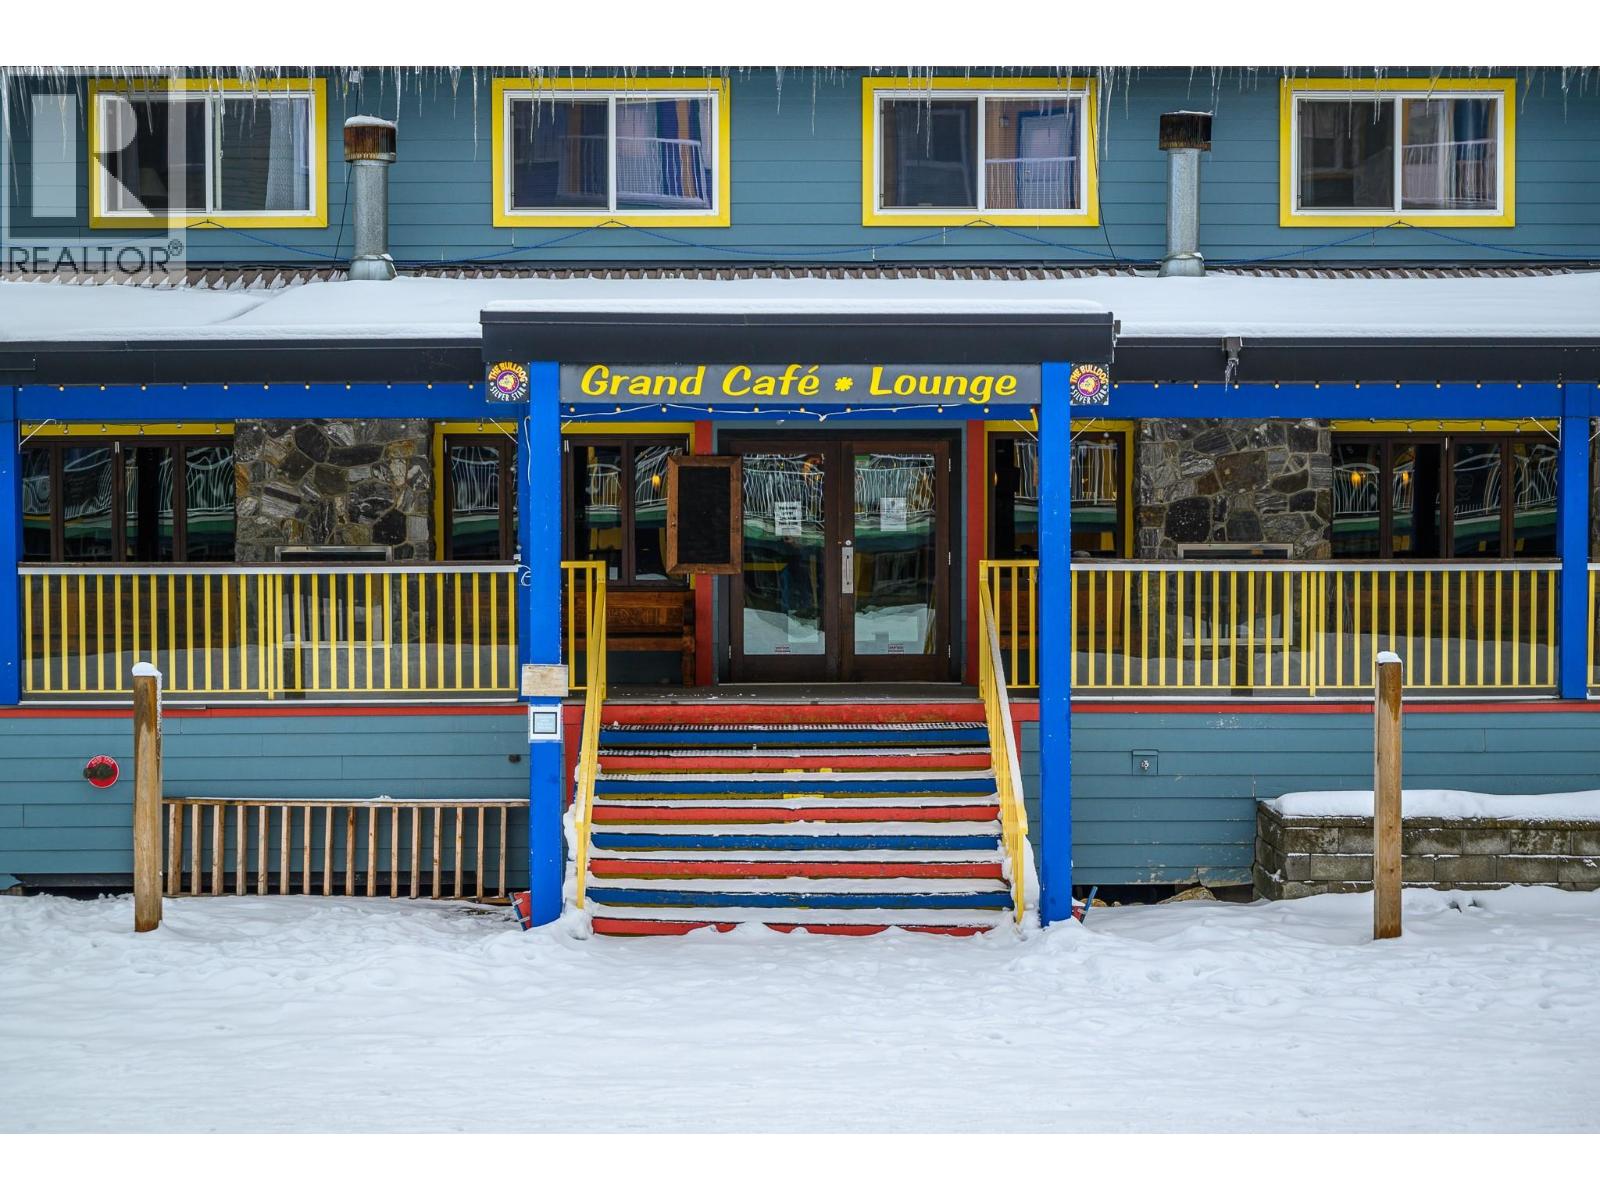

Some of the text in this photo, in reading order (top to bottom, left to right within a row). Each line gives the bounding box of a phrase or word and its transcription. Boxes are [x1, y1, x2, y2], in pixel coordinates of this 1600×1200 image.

[488, 361, 528, 384] THE BULLDOG
[1070, 364, 1109, 385] THE BULLDOG
[490, 386, 527, 402] SILVER STAR
[580, 364, 1017, 404] Grand Café Lounge
[1071, 389, 1107, 405] SILVER STAR
